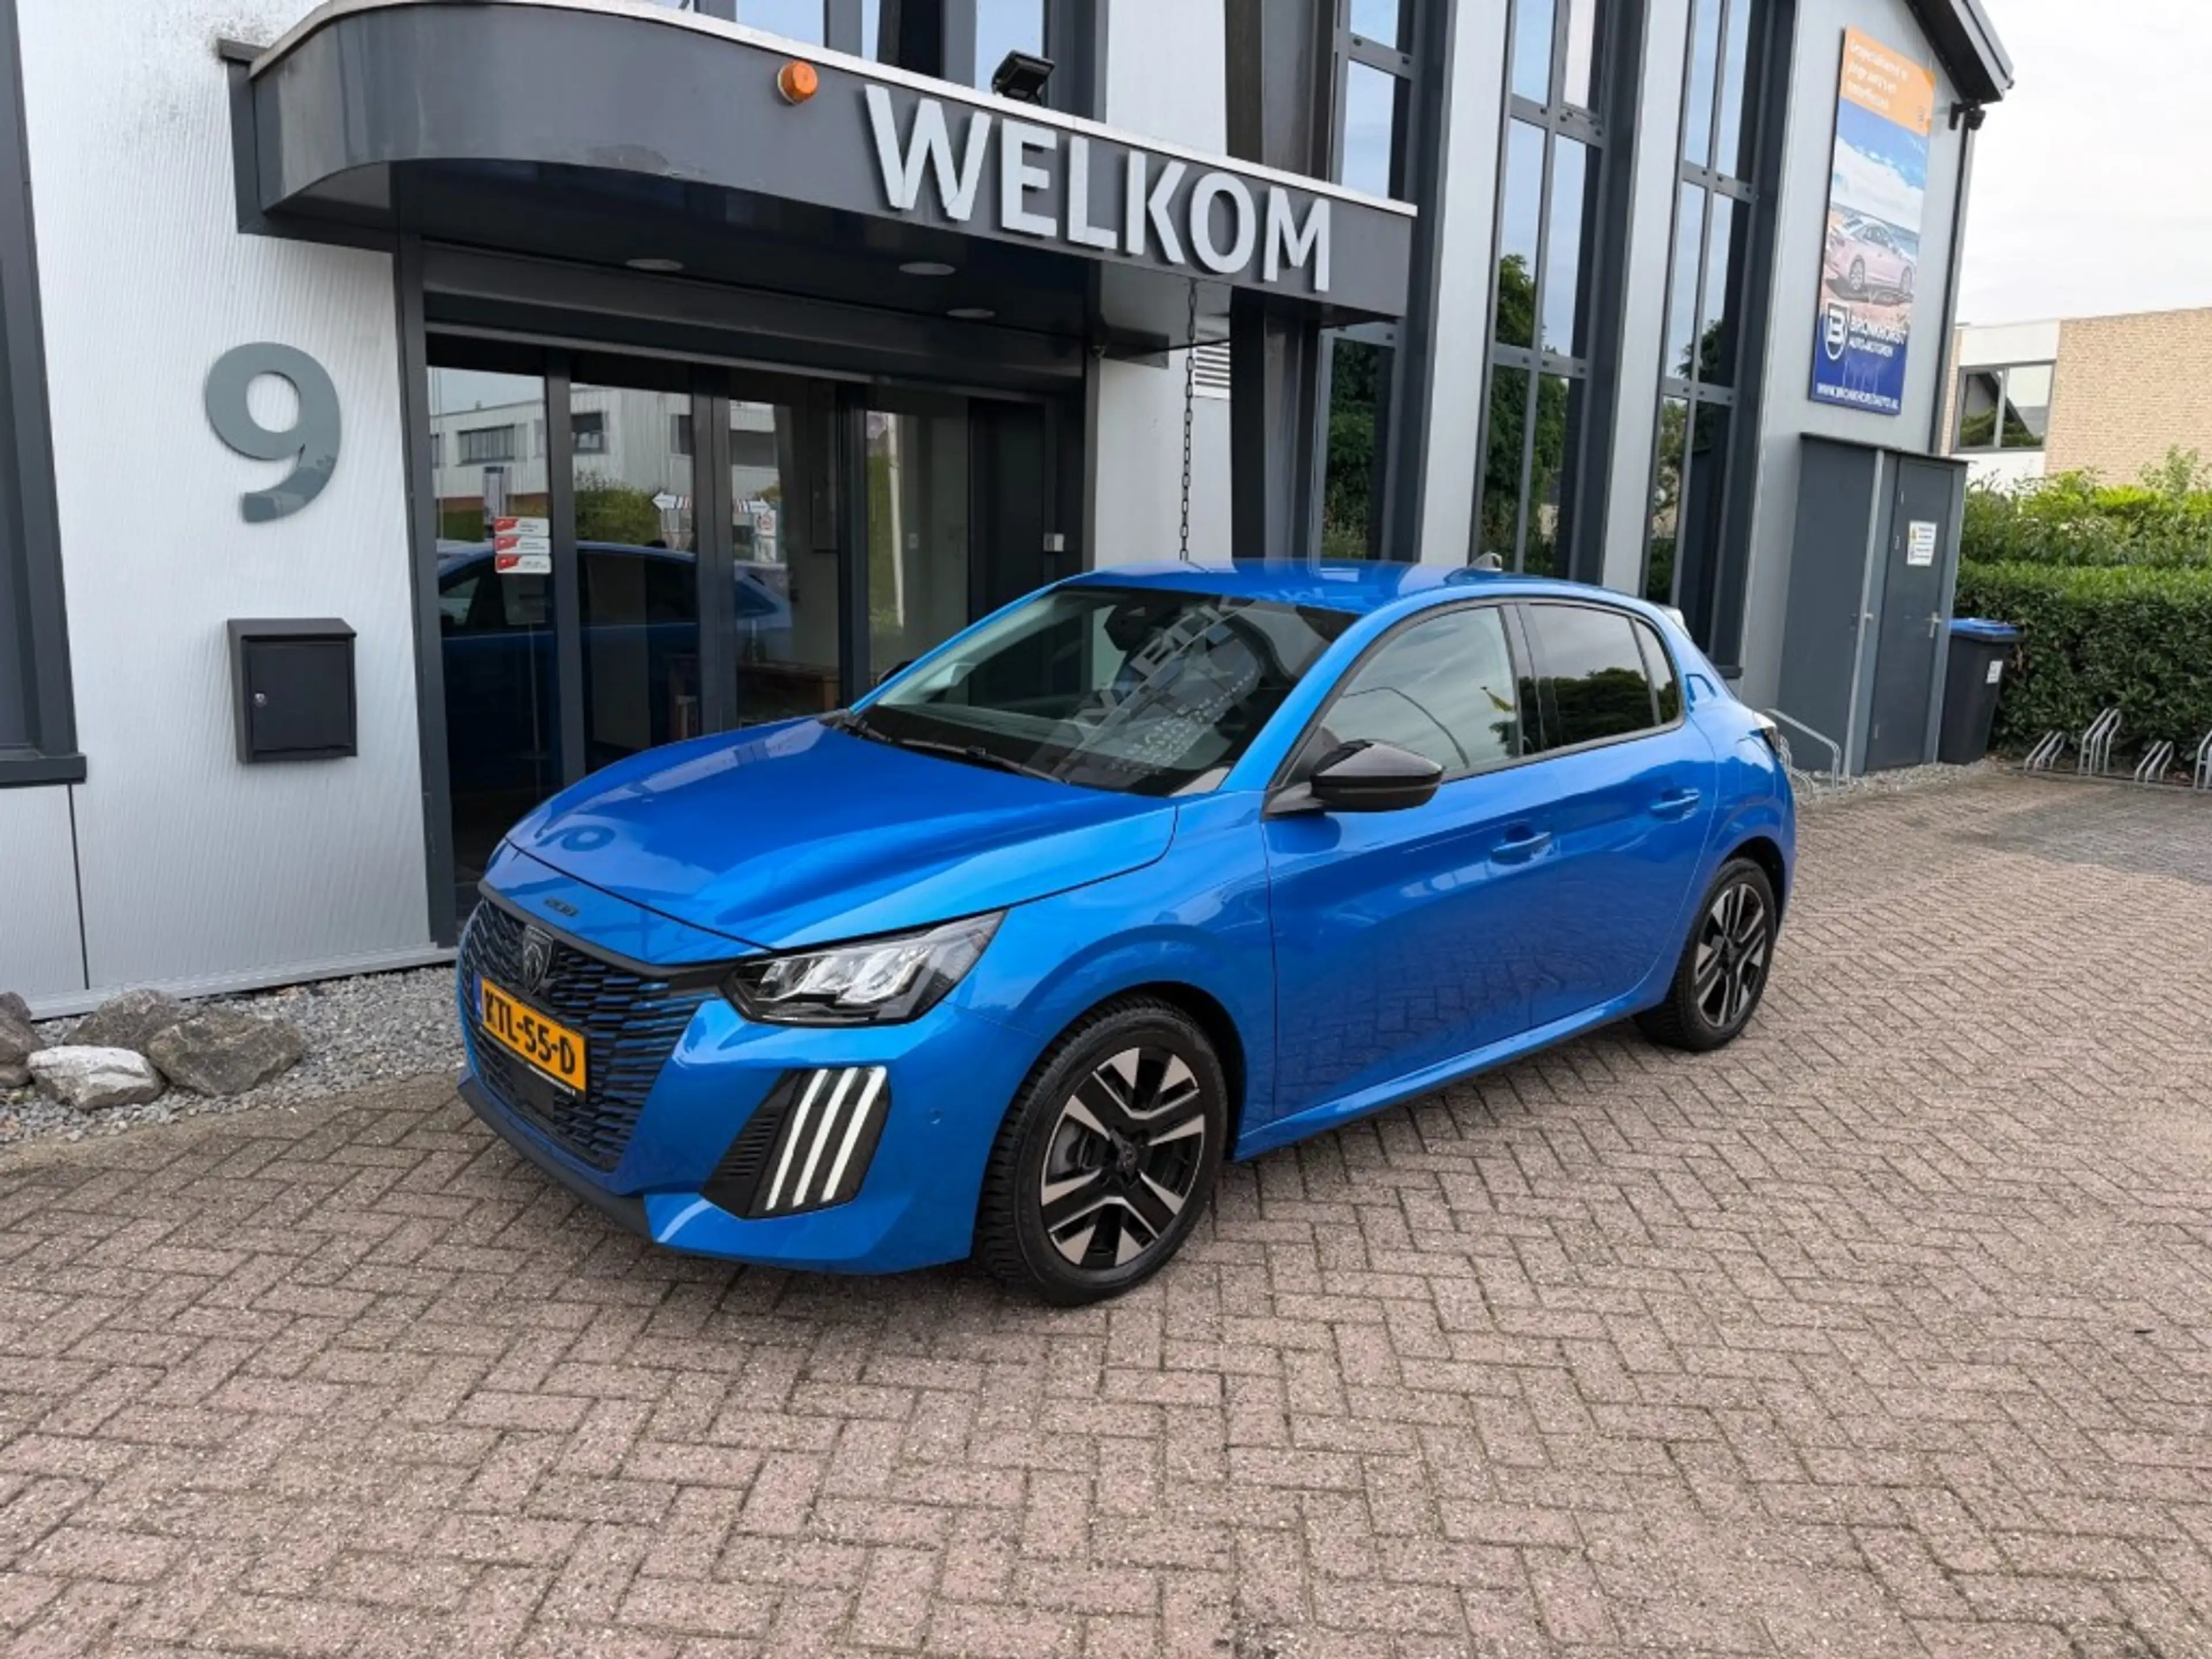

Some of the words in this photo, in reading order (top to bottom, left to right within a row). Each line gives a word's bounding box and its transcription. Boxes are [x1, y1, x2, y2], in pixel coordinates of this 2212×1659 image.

[865, 85, 1331, 293] WELKOM
[205, 342, 341, 522] 9
[484, 989, 575, 1074] KTL-55-D
